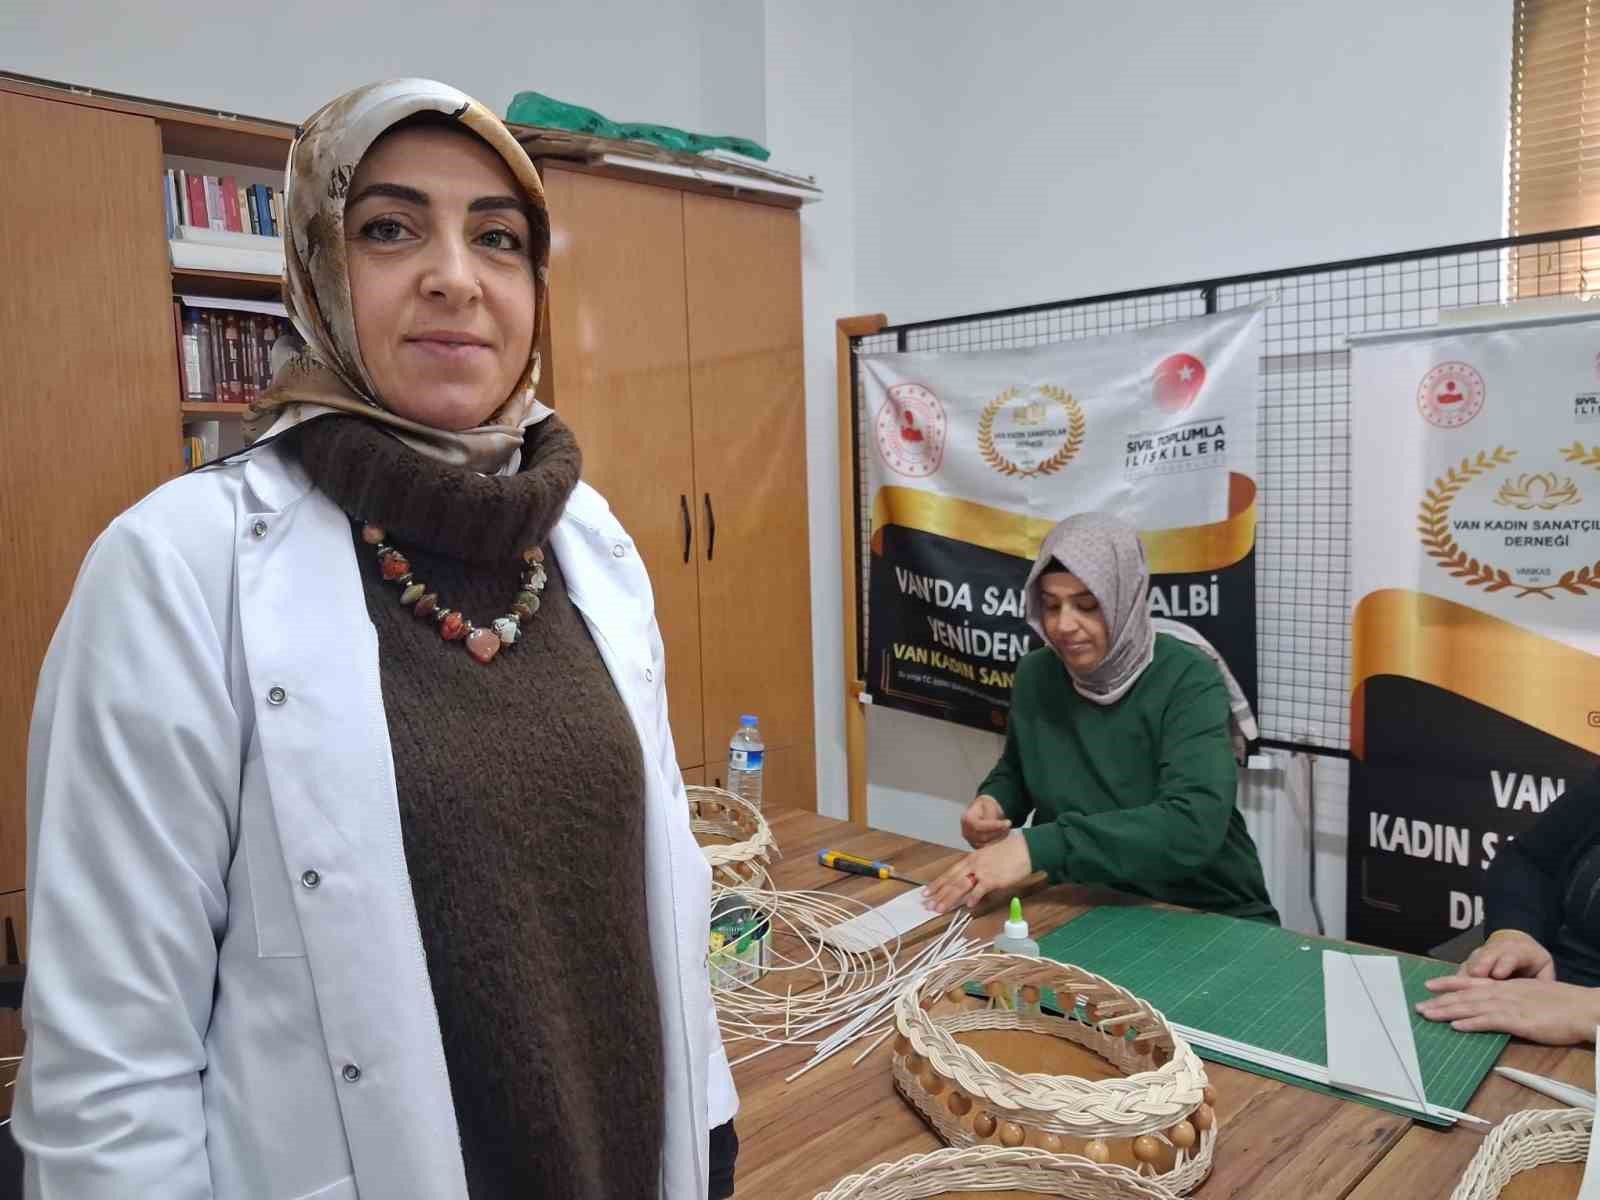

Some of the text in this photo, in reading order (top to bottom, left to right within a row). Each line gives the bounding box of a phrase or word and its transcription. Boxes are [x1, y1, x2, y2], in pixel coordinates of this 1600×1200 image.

[1453, 520, 1480, 531] VAN
[1484, 520, 1528, 531] KADIN
[1504, 535, 1569, 547] DERNEĞİ
[895, 566, 973, 612] VAN'DA
[927, 615, 1030, 662] YENİDEN
[893, 643, 928, 664] VAN
[930, 650, 975, 681] KADIN
[1490, 770, 1566, 813] VAN
[1369, 812, 1514, 870] KADIN S
